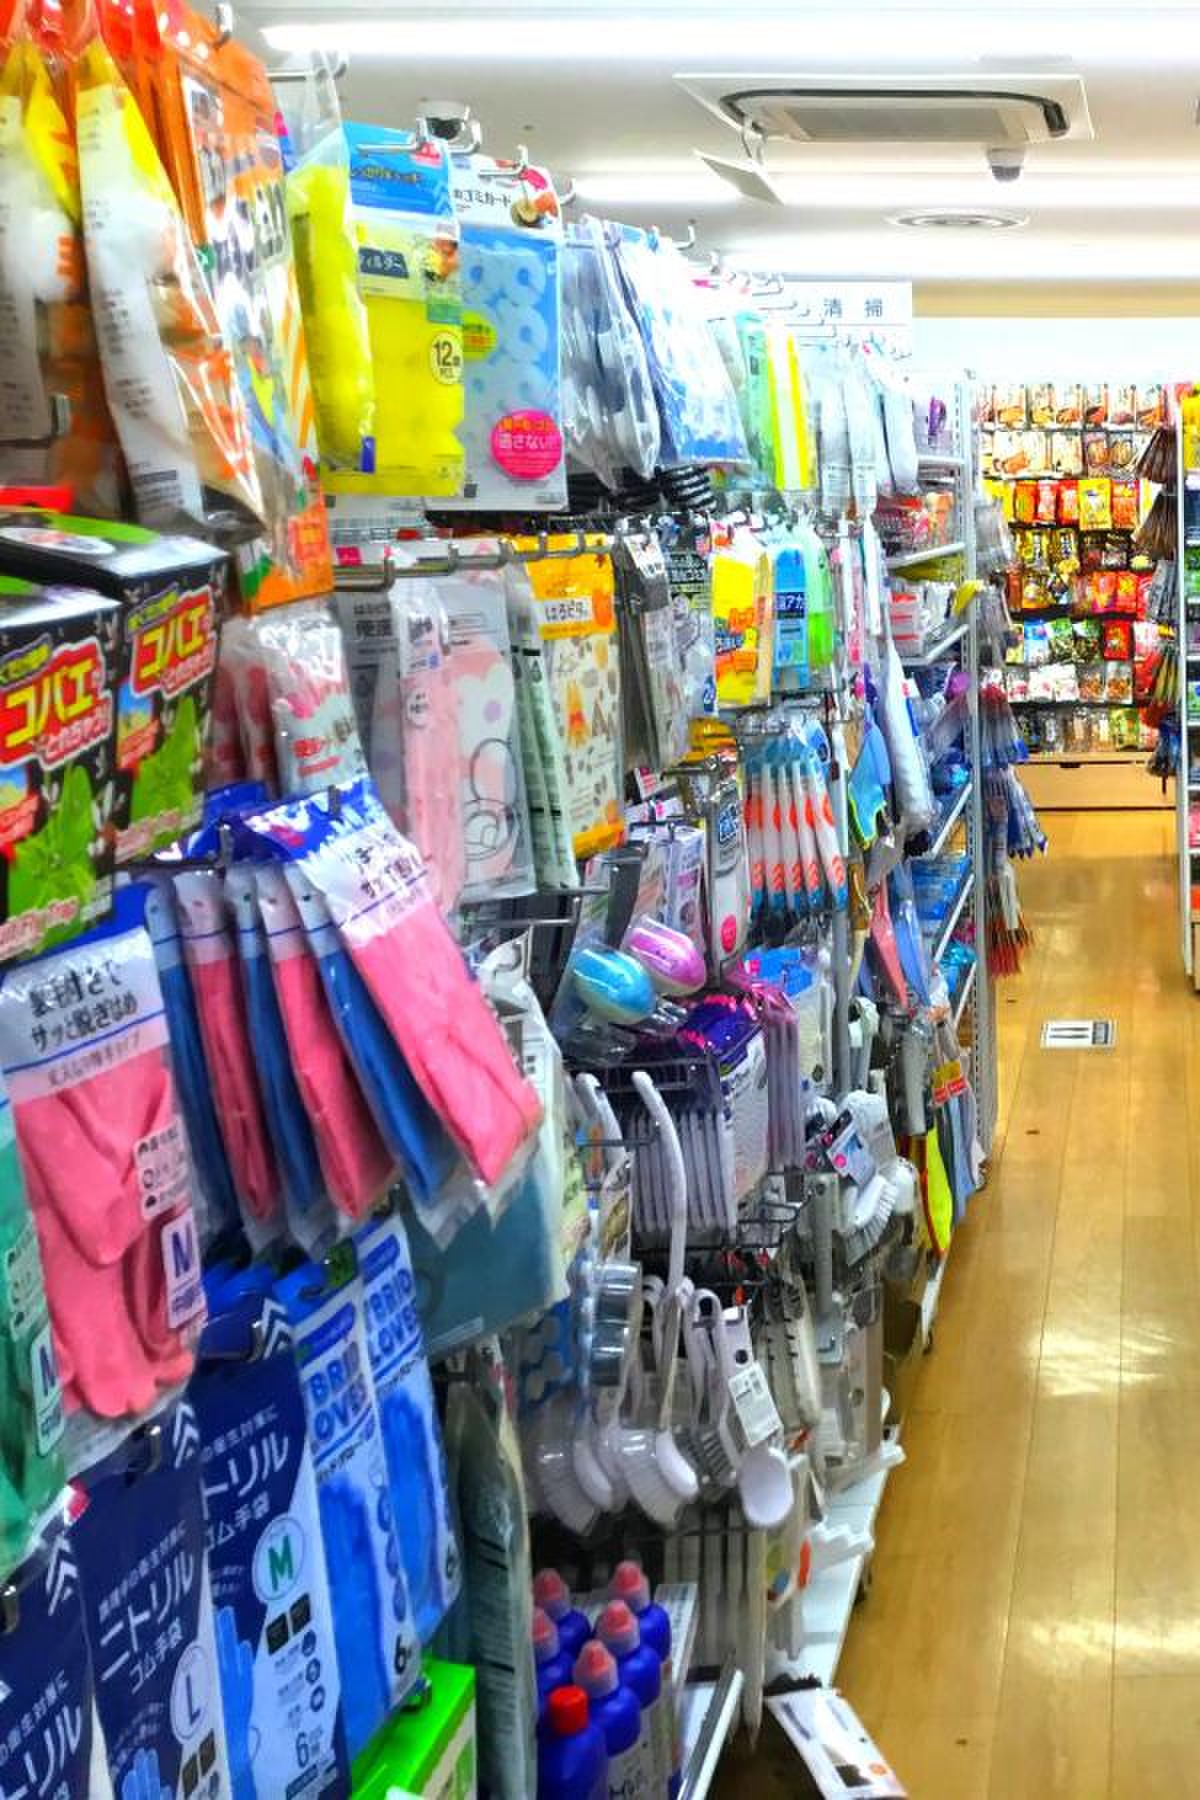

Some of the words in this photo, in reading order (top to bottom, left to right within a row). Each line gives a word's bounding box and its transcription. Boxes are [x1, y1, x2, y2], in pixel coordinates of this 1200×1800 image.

[268, 1535, 295, 1592] M
[100, 1551, 194, 1681] ニトリル
